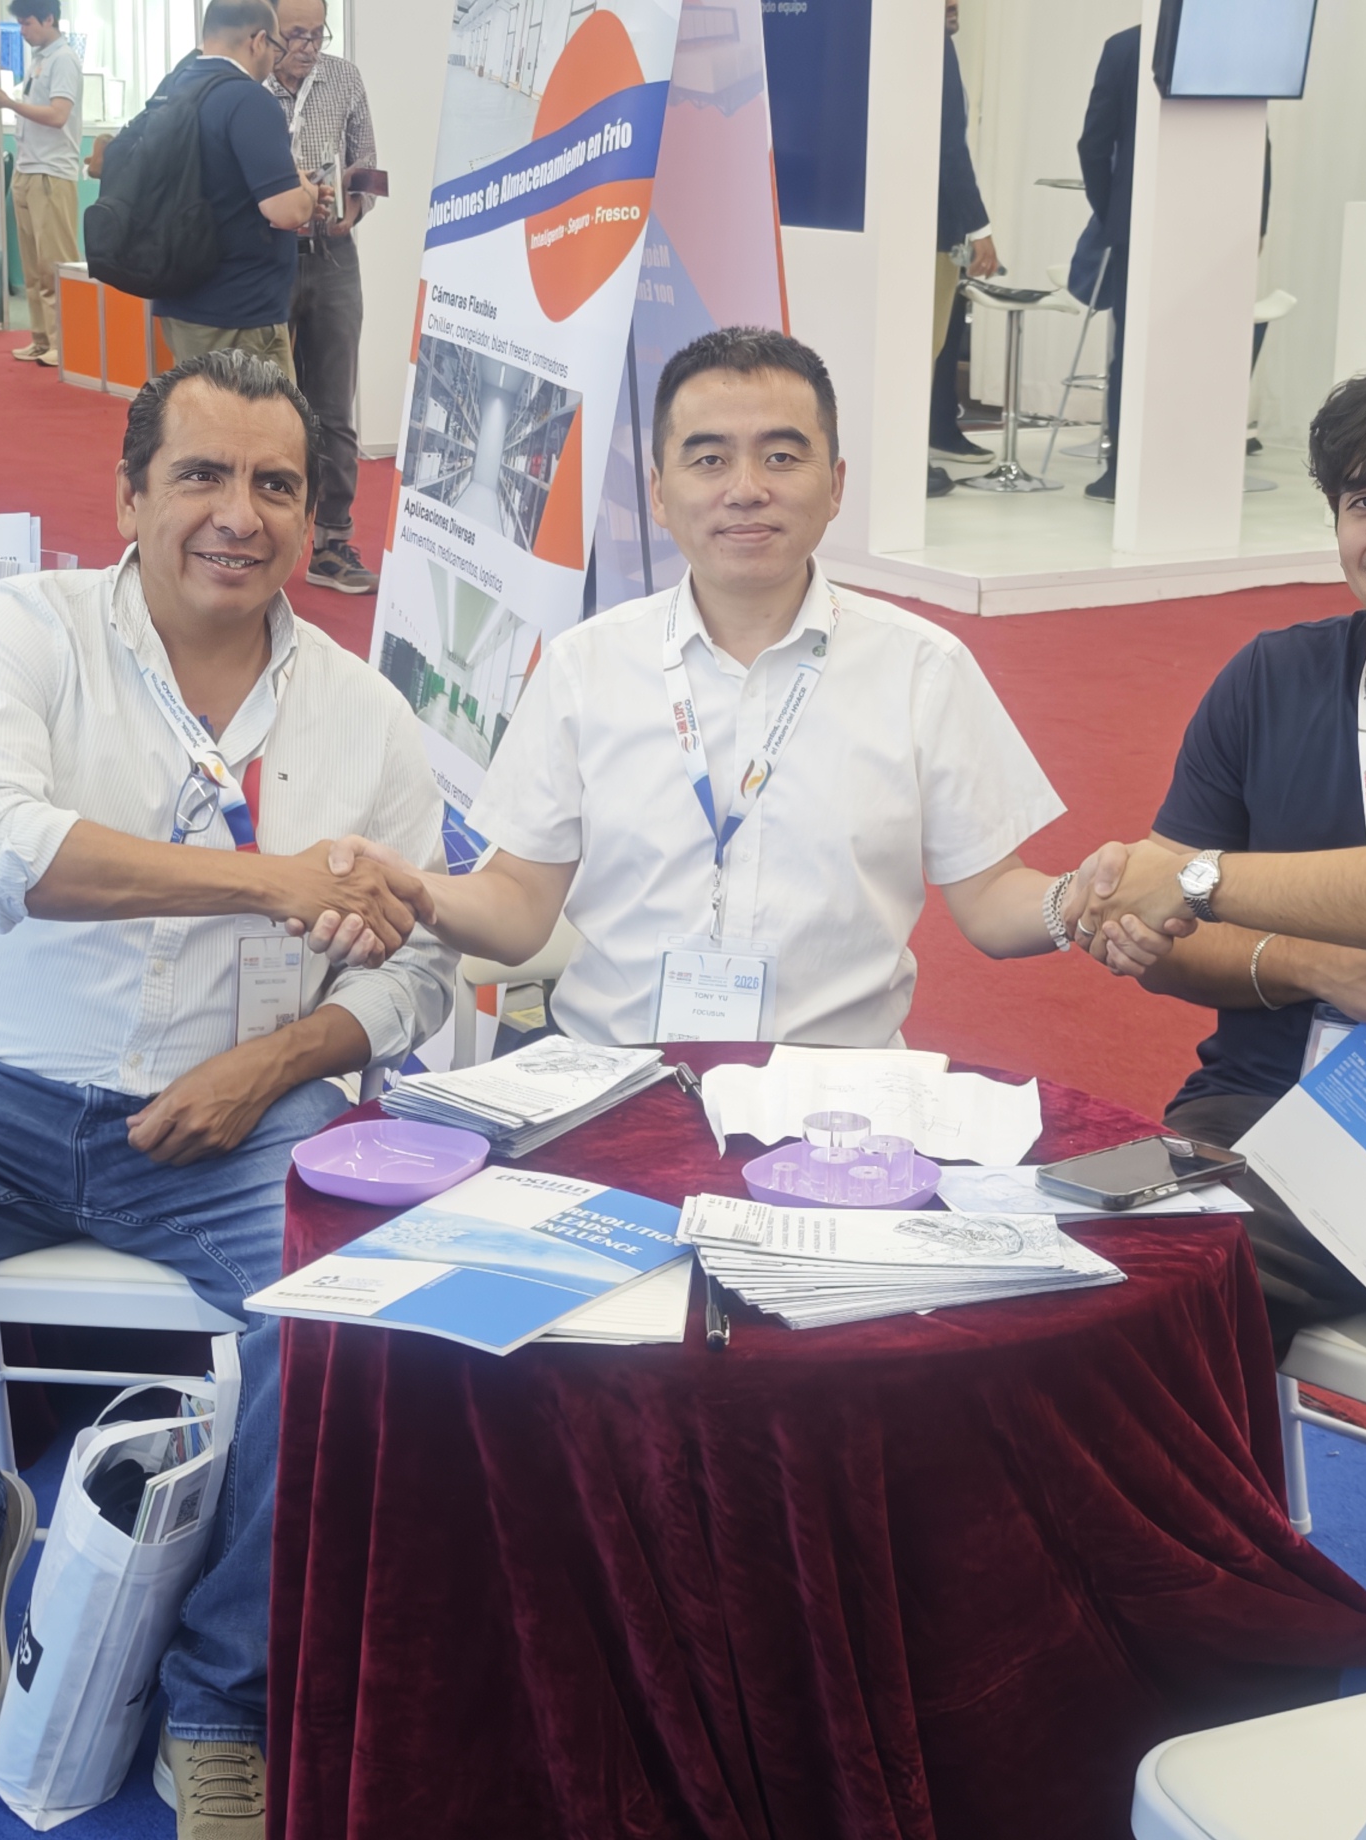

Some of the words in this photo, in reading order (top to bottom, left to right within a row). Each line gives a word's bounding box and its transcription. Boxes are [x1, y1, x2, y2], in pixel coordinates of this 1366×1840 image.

[427, 190, 484, 230] oluciones
[485, 181, 499, 210] de
[499, 140, 585, 204] Almacenamiento
[586, 132, 601, 162] en
[602, 118, 633, 155] Frío
[530, 225, 565, 250] Inteligente
[567, 213, 590, 236] Seguro
[595, 206, 641, 224] Fresco
[431, 285, 467, 310] Cámaras
[467, 295, 498, 320] Flexibles
[428, 313, 455, 338] Chiller,
[455, 324, 491, 351] congelador,
[491, 334, 509, 354] blast
[508, 340, 531, 366] freezer,
[404, 497, 449, 532] Aplicaciones
[449, 517, 476, 546] Diversas
[400, 525, 436, 557] Alimentos,
[437, 543, 478, 581] medicamentos,
[762, 723, 781, 752] Juntos,
[776, 672, 805, 723] impulsaremos
[775, 724, 789, 748] futuro
[786, 713, 795, 724] del
[791, 686, 807, 713] HVACR
[694, 991, 715, 1000] TONY
[718, 994, 729, 1002] YU
[734, 974, 760, 990] 2026
[692, 1008, 726, 1018] FOCUSUN
[535, 1222, 643, 1256] INFLUENCE
[550, 1214, 614, 1235] LEADS
[563, 1207, 683, 1247] REVOLUTION
